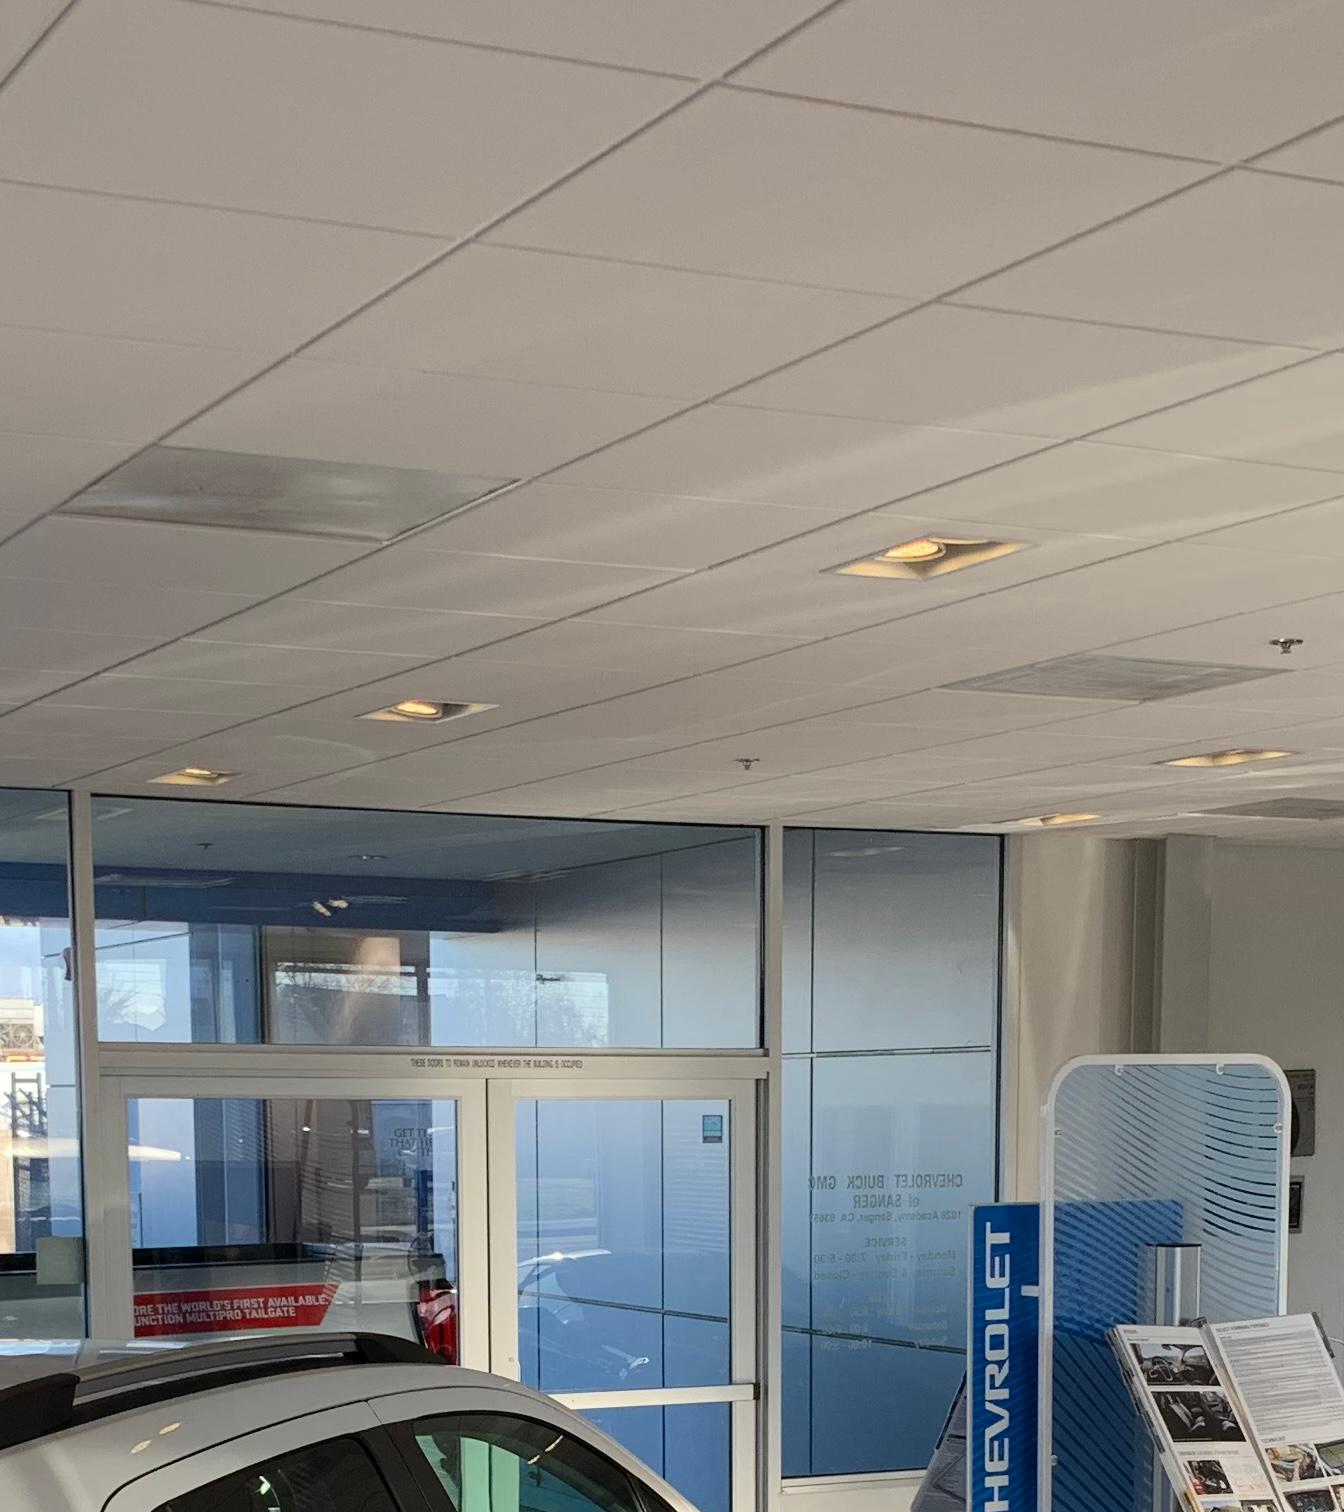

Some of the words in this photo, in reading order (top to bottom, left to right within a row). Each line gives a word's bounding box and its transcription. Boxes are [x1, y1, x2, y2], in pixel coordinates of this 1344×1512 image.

[156, 1303, 179, 1315] THE
[180, 1299, 231, 1313] WORLD'S
[233, 1298, 265, 1310] FIRST
[185, 1309, 241, 1324] MULTIPRO
[244, 1307, 296, 1320] TAILGATE
